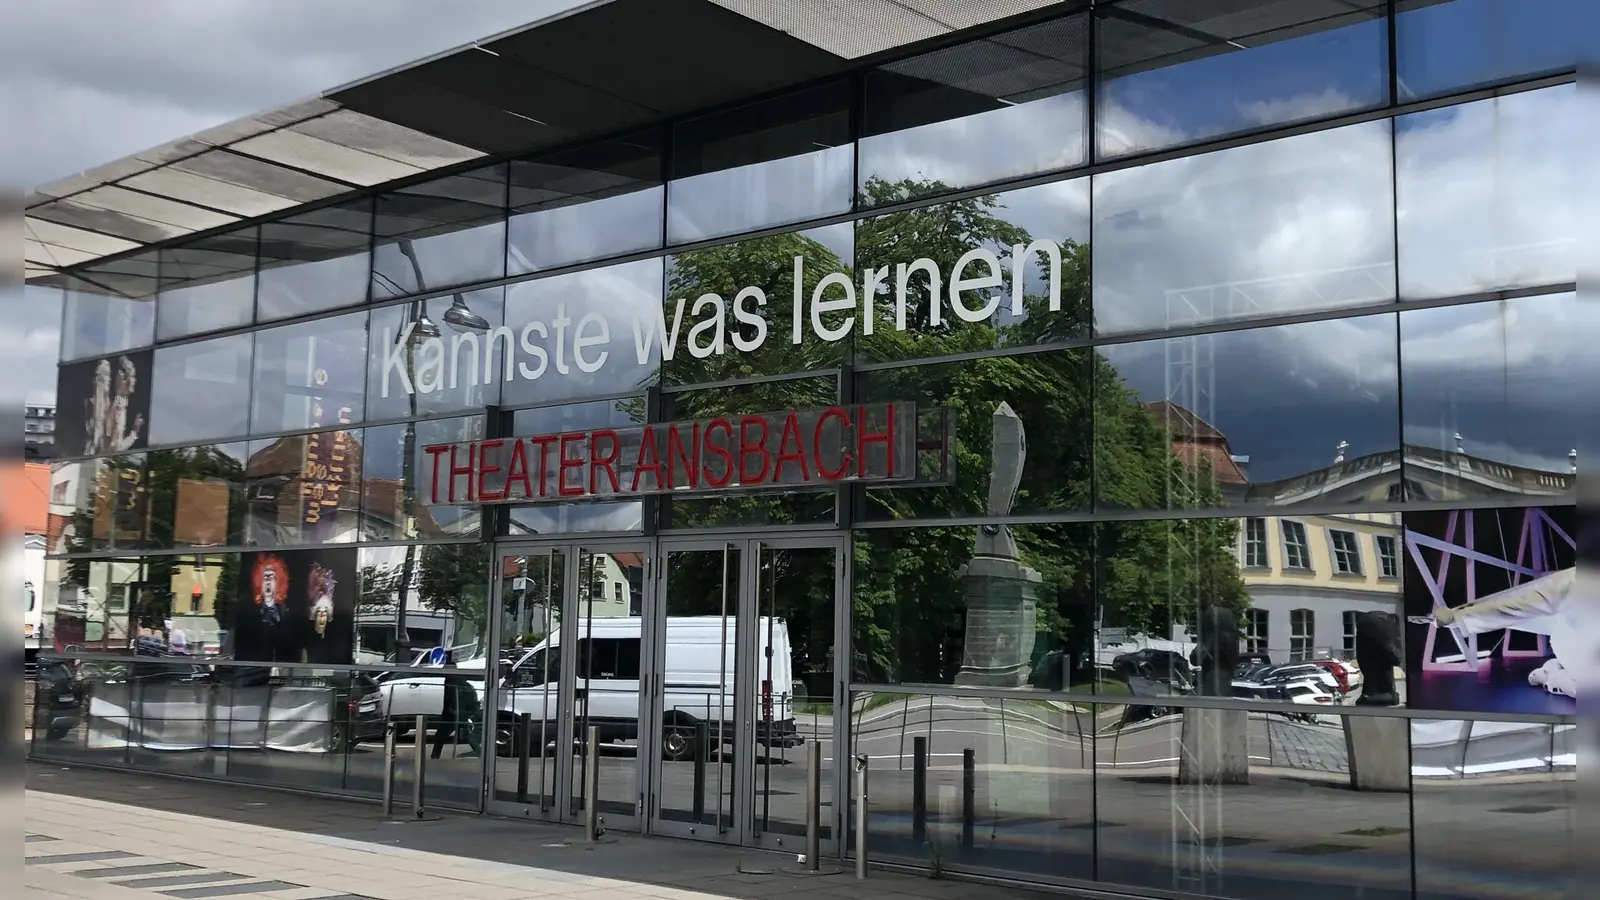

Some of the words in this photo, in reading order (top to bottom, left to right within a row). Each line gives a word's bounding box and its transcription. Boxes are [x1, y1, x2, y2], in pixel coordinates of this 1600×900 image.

[381, 302, 610, 398] Kannste
[633, 286, 768, 365] was
[793, 238, 1062, 345] lernen
[424, 428, 621, 503] THEATER
[631, 403, 895, 491] ANSBACH
